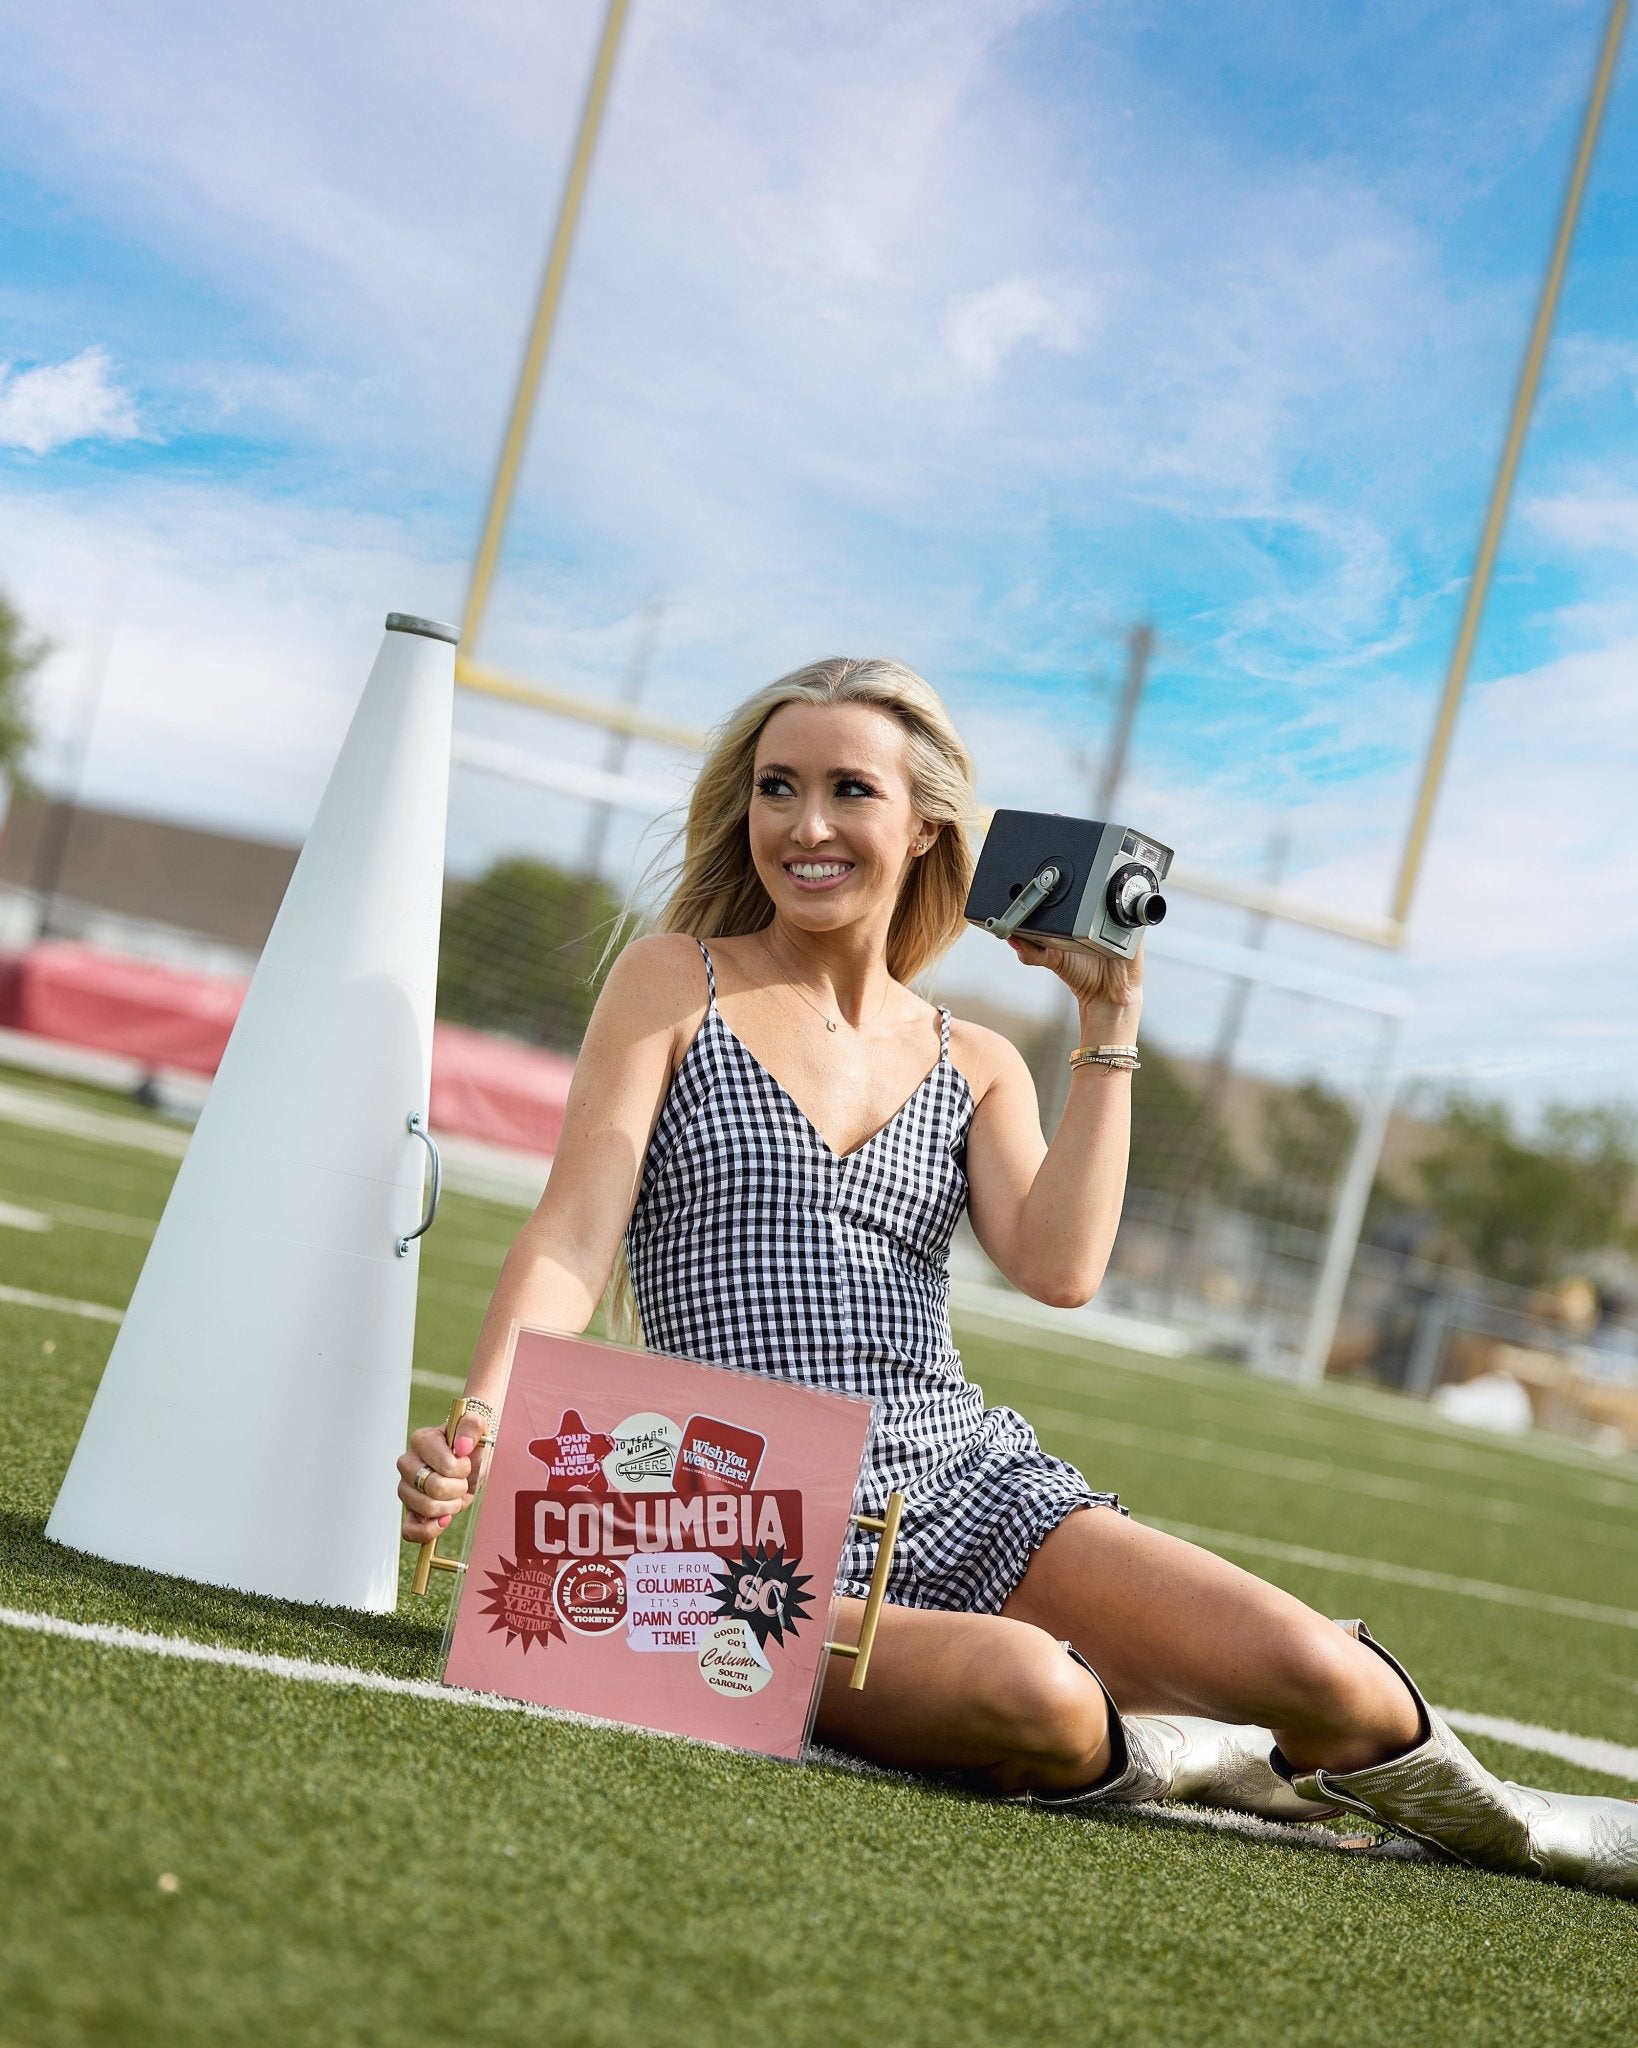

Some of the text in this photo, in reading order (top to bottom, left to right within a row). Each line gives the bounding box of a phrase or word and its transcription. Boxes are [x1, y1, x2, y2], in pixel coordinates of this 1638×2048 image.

[555, 1433, 591, 1446] YOUR
[630, 1426, 668, 1446] TEARS!
[560, 1443, 588, 1456] FAV
[627, 1440, 654, 1456] MORE
[692, 1438, 748, 1469] Wish You
[554, 1453, 596, 1466] LIVES
[624, 1458, 668, 1472] CHEERS
[682, 1449, 752, 1483] Were Here!
[550, 1462, 600, 1476] IN COLA
[534, 1494, 787, 1554] COLUMBIA
[636, 1564, 710, 1574] LIVE FROM
[562, 1563, 626, 1607] WILL WORK FOR
[636, 1578, 714, 1594] COLUMBIA
[734, 1574, 789, 1617] SC
[651, 1598, 697, 1608] IT'S A
[568, 1606, 620, 1615] FOOTBALL
[572, 1615, 615, 1624] TICKETS
[633, 1610, 719, 1627] DAMN GOOD
[652, 1631, 696, 1646] TIME!
[714, 1627, 740, 1639] GOOD
[727, 1638, 740, 1647] GO
[718, 1668, 749, 1681] SOUTH
[709, 1677, 753, 1693] CAROLINA
